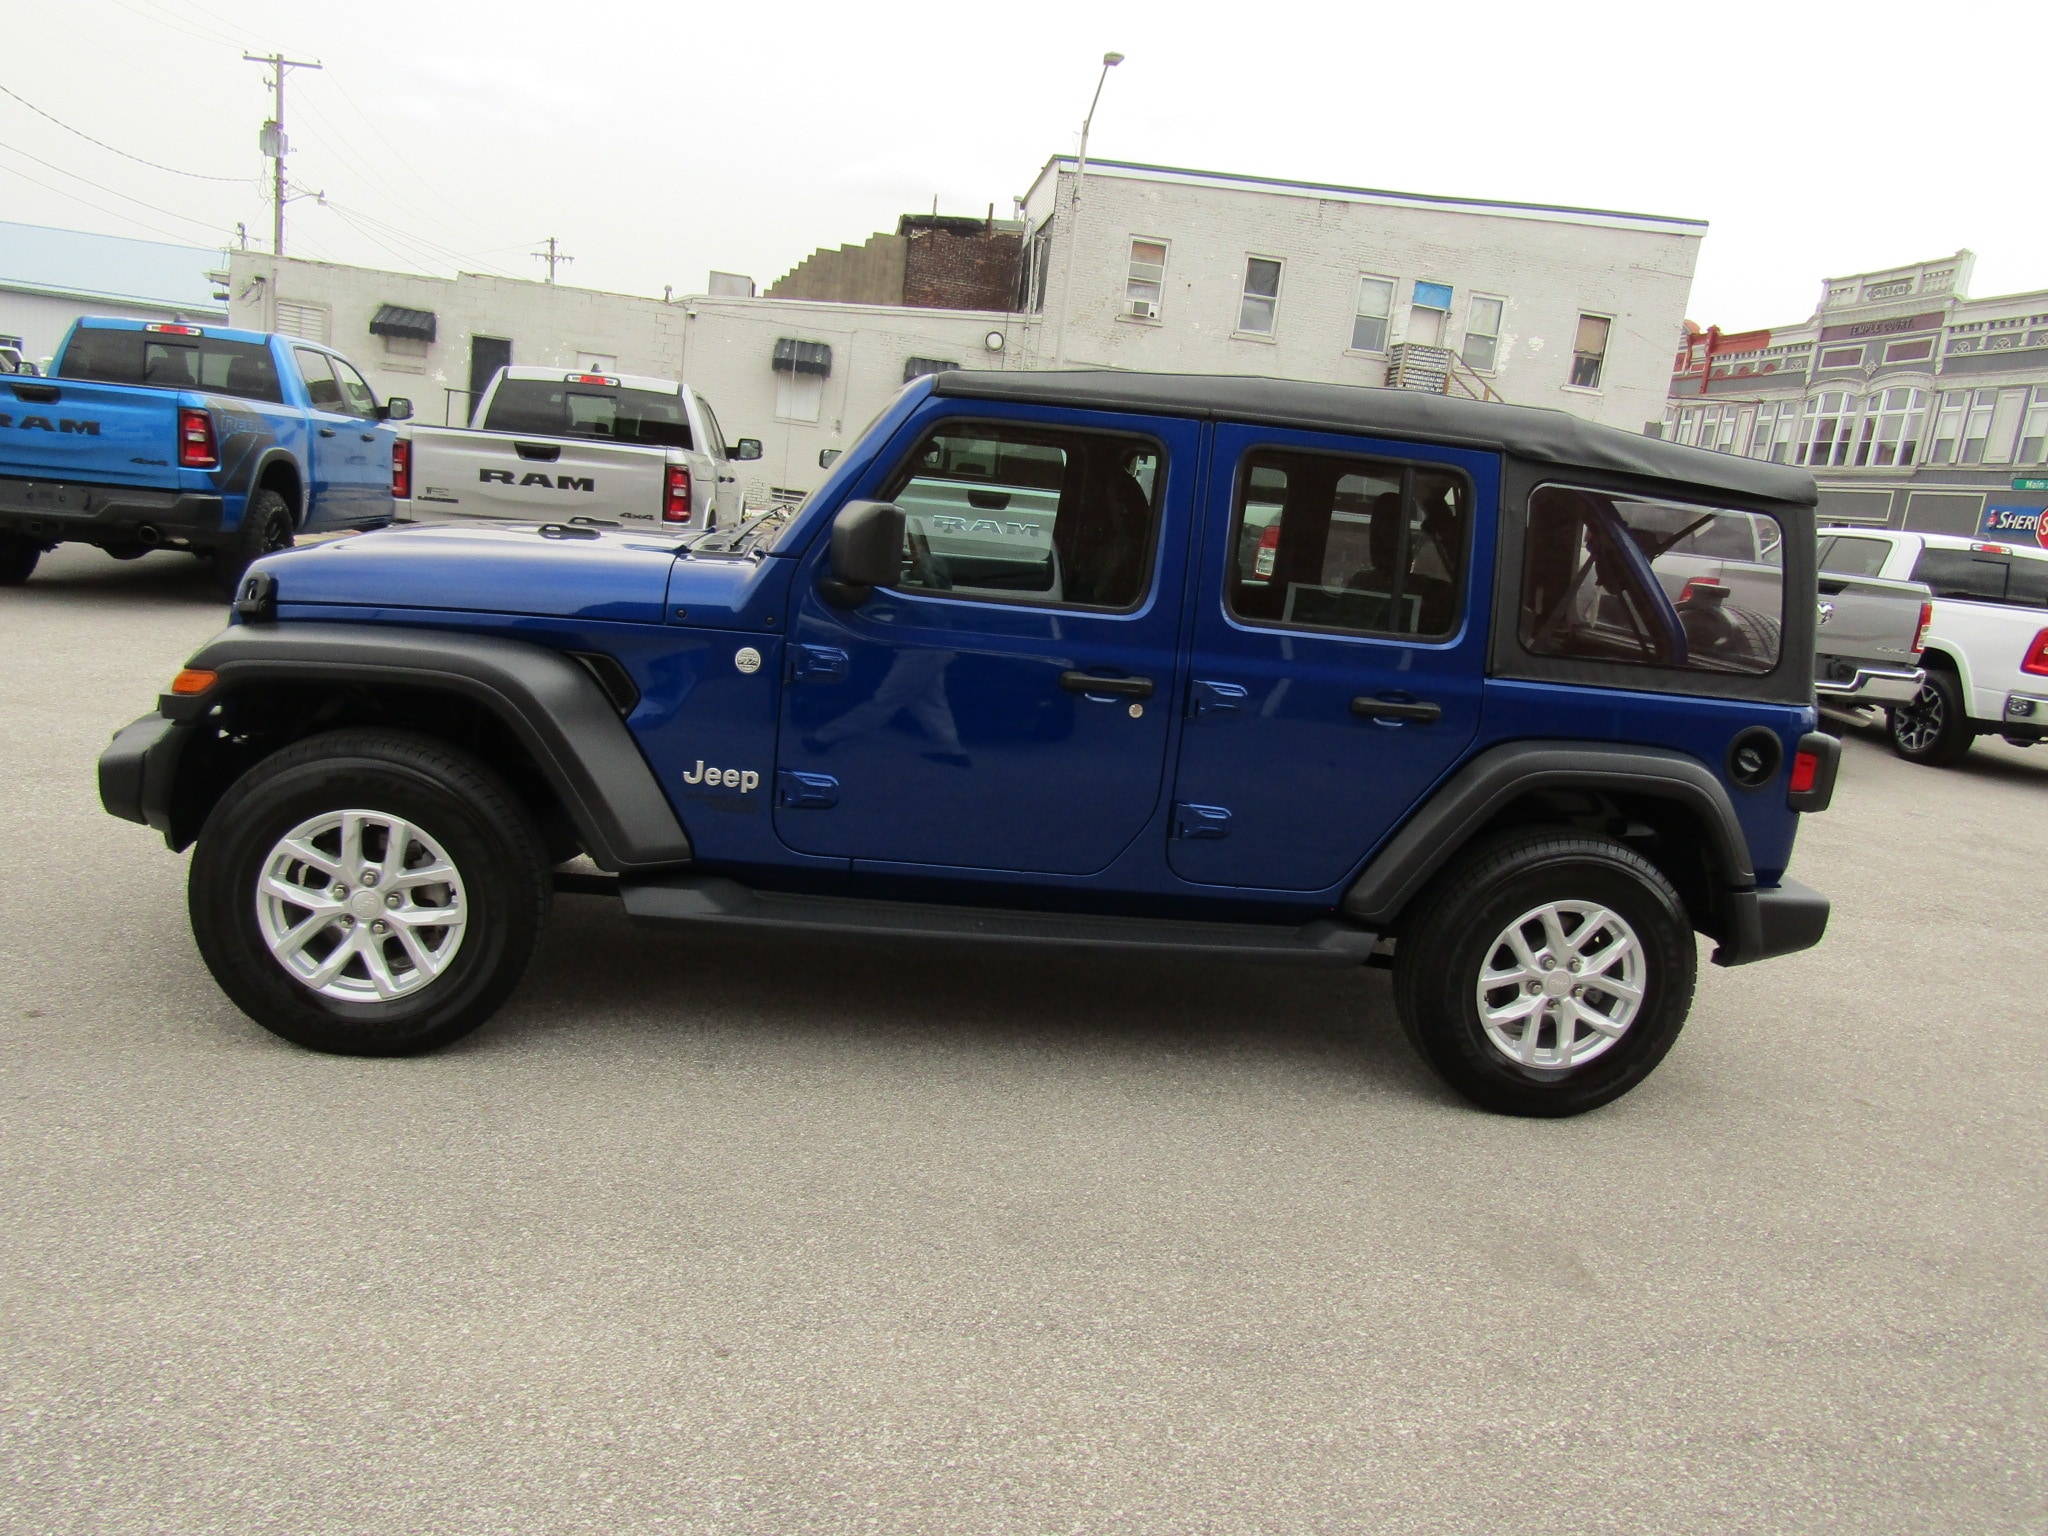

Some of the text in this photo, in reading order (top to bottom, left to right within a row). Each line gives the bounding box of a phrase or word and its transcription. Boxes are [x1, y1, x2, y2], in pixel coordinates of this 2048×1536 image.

[1850, 324, 1882, 336] TEMPLE
[479, 468, 595, 492] RAM
[2025, 480, 2044, 489] Main
[933, 514, 1040, 537] RAM
[683, 760, 760, 793] Jeep
